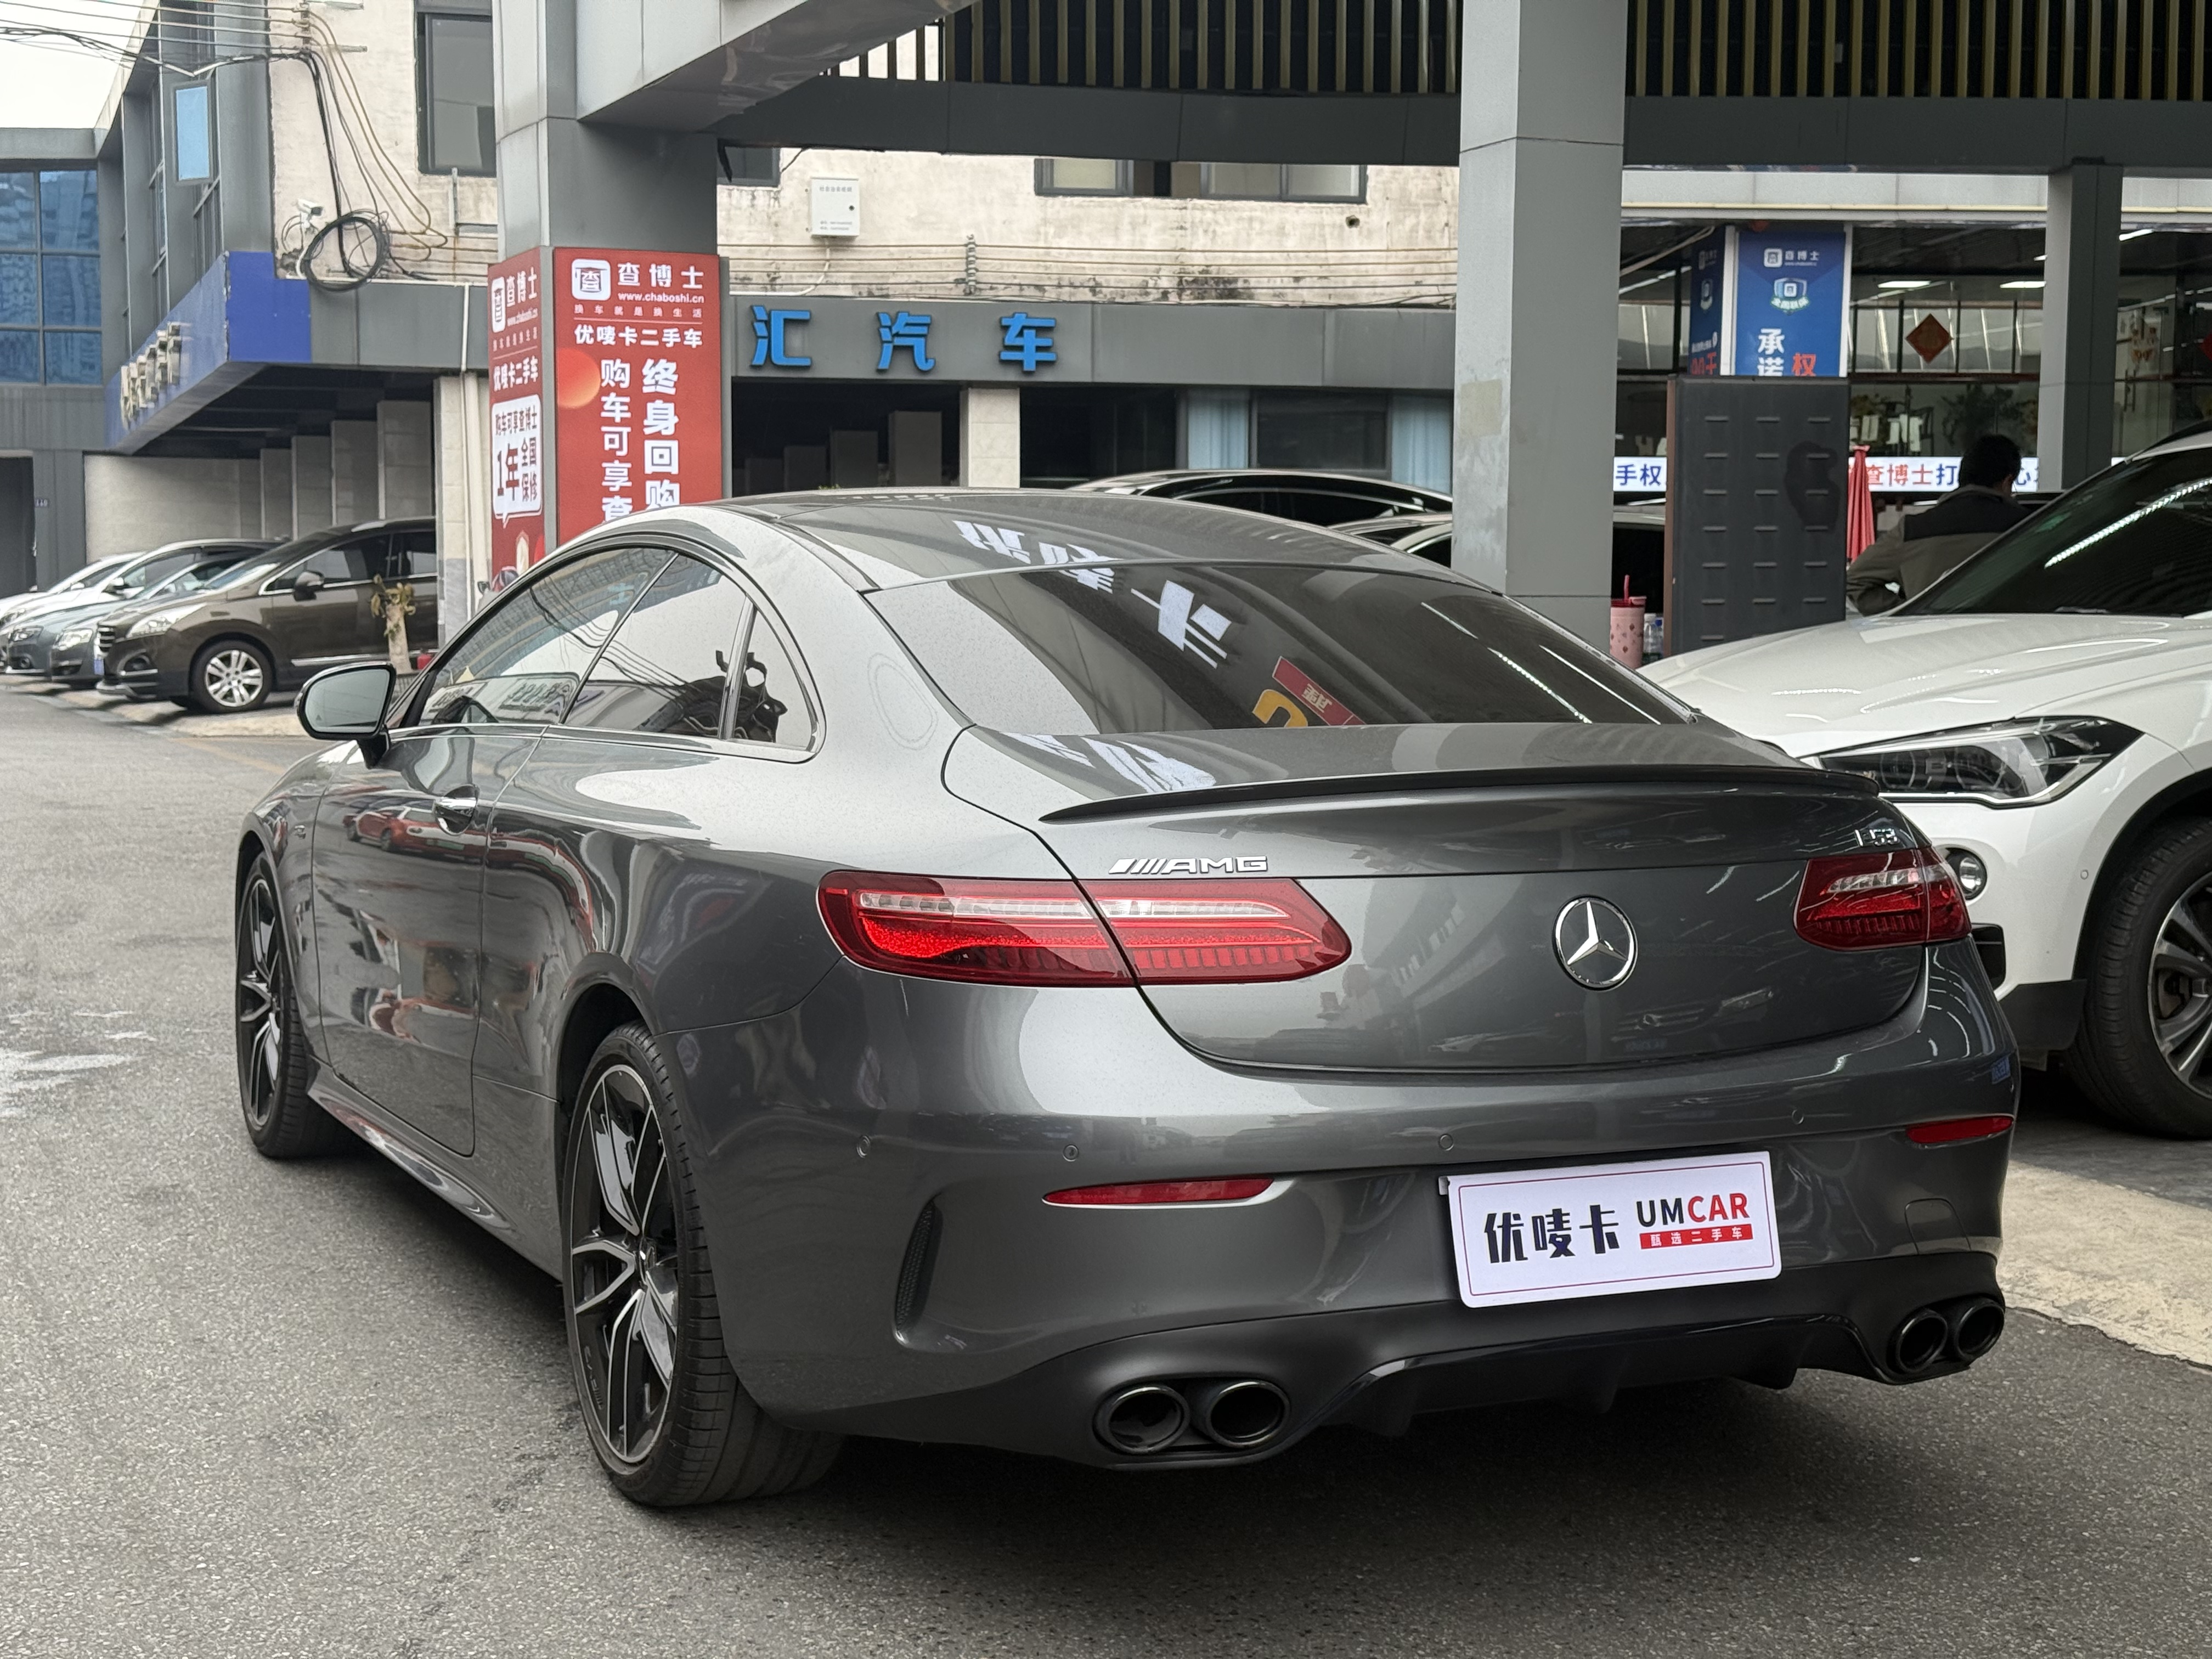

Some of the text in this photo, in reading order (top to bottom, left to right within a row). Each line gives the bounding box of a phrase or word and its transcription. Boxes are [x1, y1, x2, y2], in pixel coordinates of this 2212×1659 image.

[506, 267, 537, 307] 查博士
[618, 262, 704, 289] 查博士
[618, 292, 704, 303] www.chaboshi.cn
[574, 324, 703, 348] 优唛卡二手车
[751, 304, 1057, 372] 汇汽车
[1757, 328, 1785, 376] 承诺
[494, 354, 538, 392] 优唛卡二手车
[1792, 352, 1816, 376] 权
[601, 358, 633, 521] 购车可享查
[642, 358, 680, 511] 终身回购
[1616, 464, 1661, 486] 手权
[1161, 856, 1267, 874] AMG
[1635, 1193, 1750, 1227] UMCAR
[1484, 1205, 1619, 1263] 优唛卡
